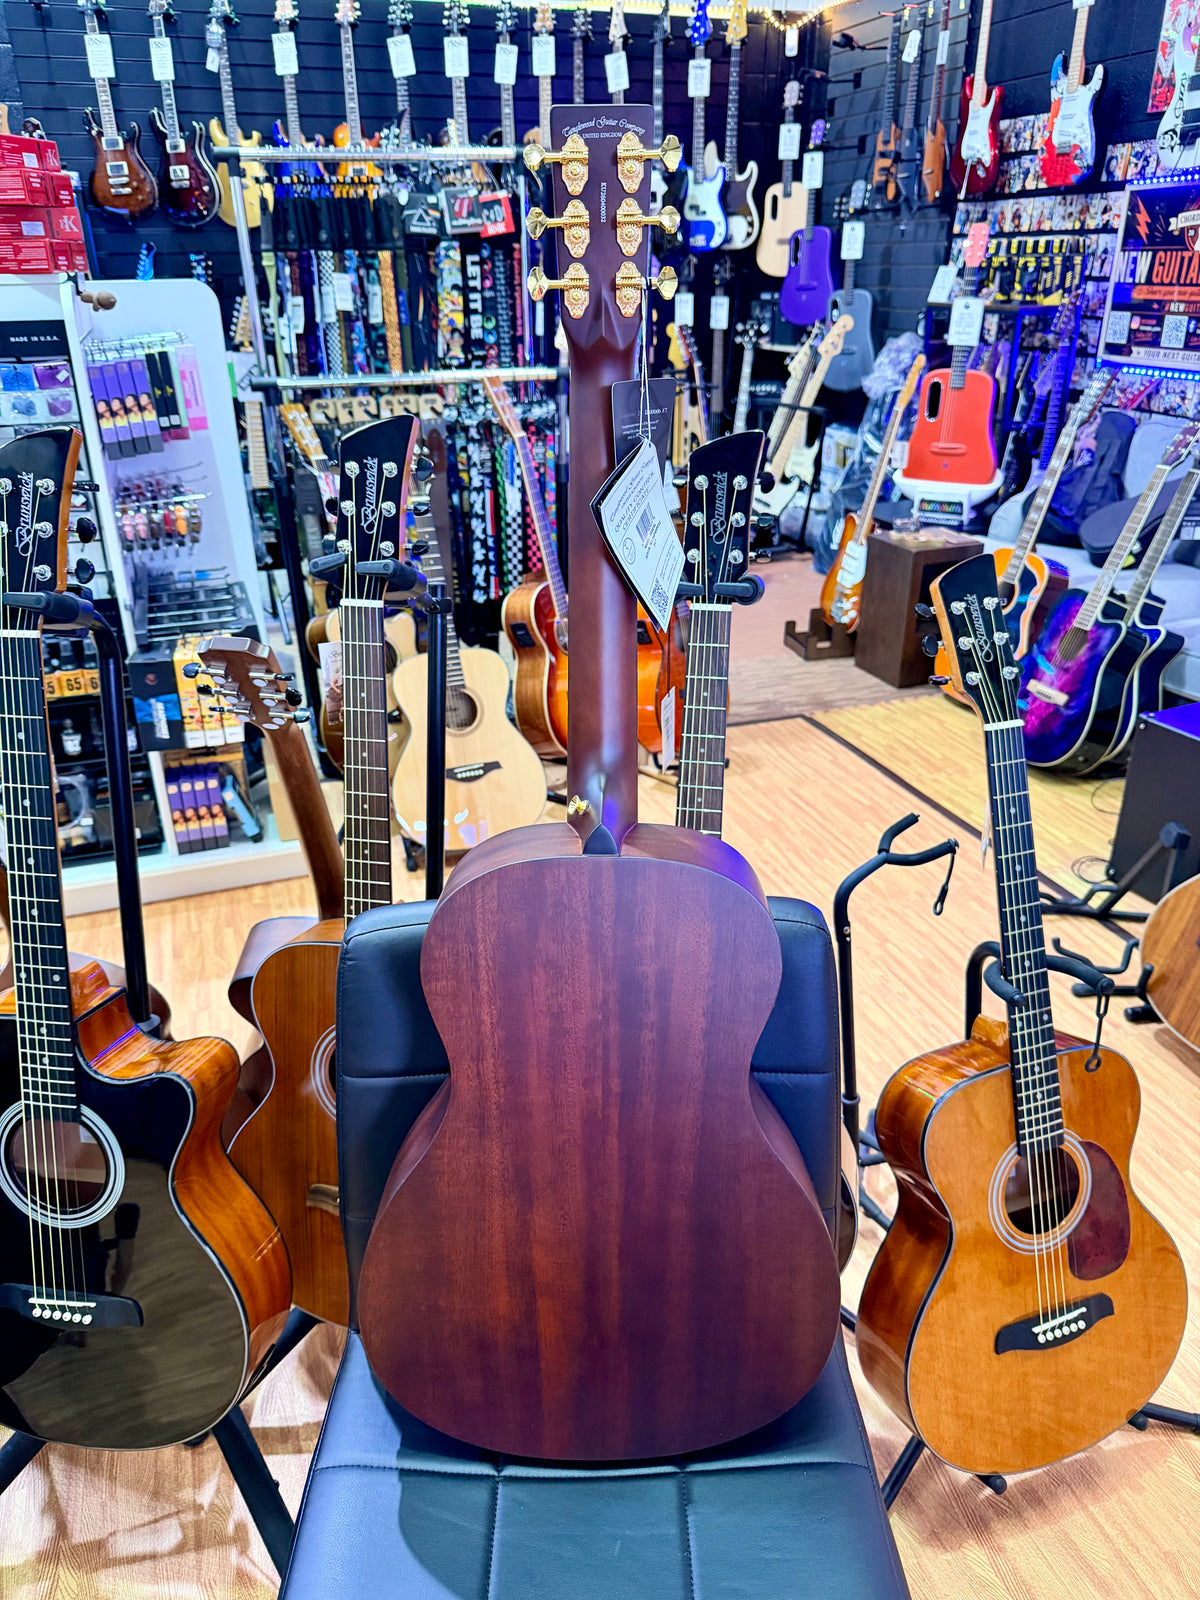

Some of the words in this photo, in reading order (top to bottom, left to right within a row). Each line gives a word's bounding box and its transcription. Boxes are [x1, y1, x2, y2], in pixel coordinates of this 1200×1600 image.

[466, 254, 482, 291] LET
[1114, 250, 1152, 284] NEW
[1152, 250, 1200, 284] GUITA
[469, 292, 482, 312] IT
[470, 314, 483, 340] BE
[360, 456, 378, 534] Brunswick
[709, 471, 728, 544] Brunswick
[15, 472, 34, 556] Brunswick
[964, 594, 993, 662] Brunswick
[66, 677, 82, 691] 65
